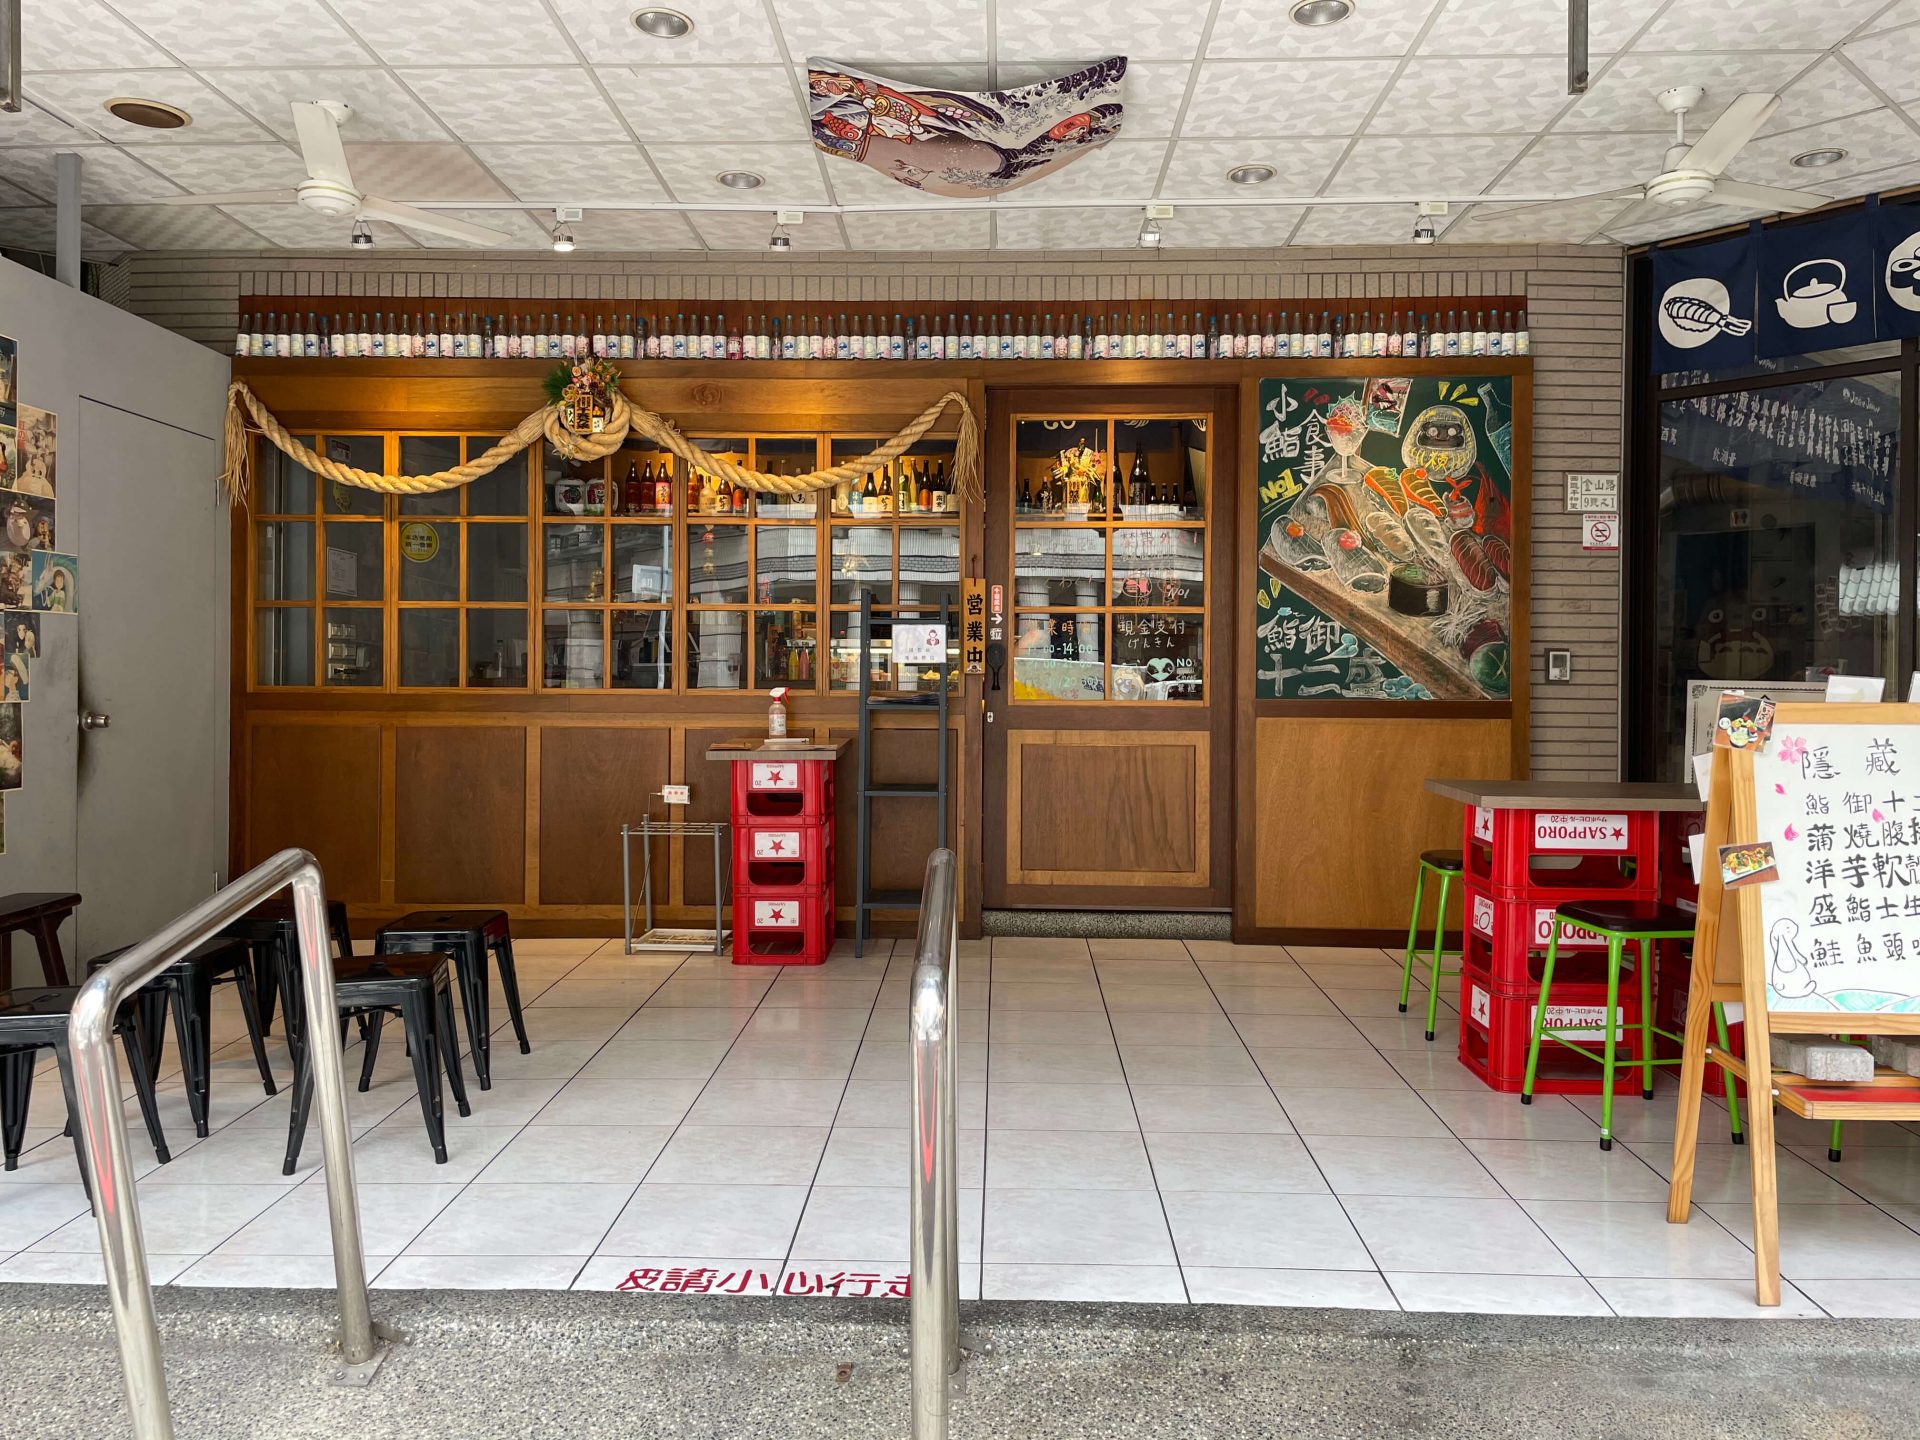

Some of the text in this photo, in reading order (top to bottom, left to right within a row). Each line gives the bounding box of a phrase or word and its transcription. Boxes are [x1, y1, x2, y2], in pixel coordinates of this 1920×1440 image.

[1259, 384, 1302, 463] 小鮨
[1292, 409, 1333, 484] 食事
[1583, 478, 1616, 492] 金山路
[967, 593, 983, 663] 営業中
[1801, 738, 1900, 779] 隱藏
[1537, 825, 1607, 840] SAPPORO
